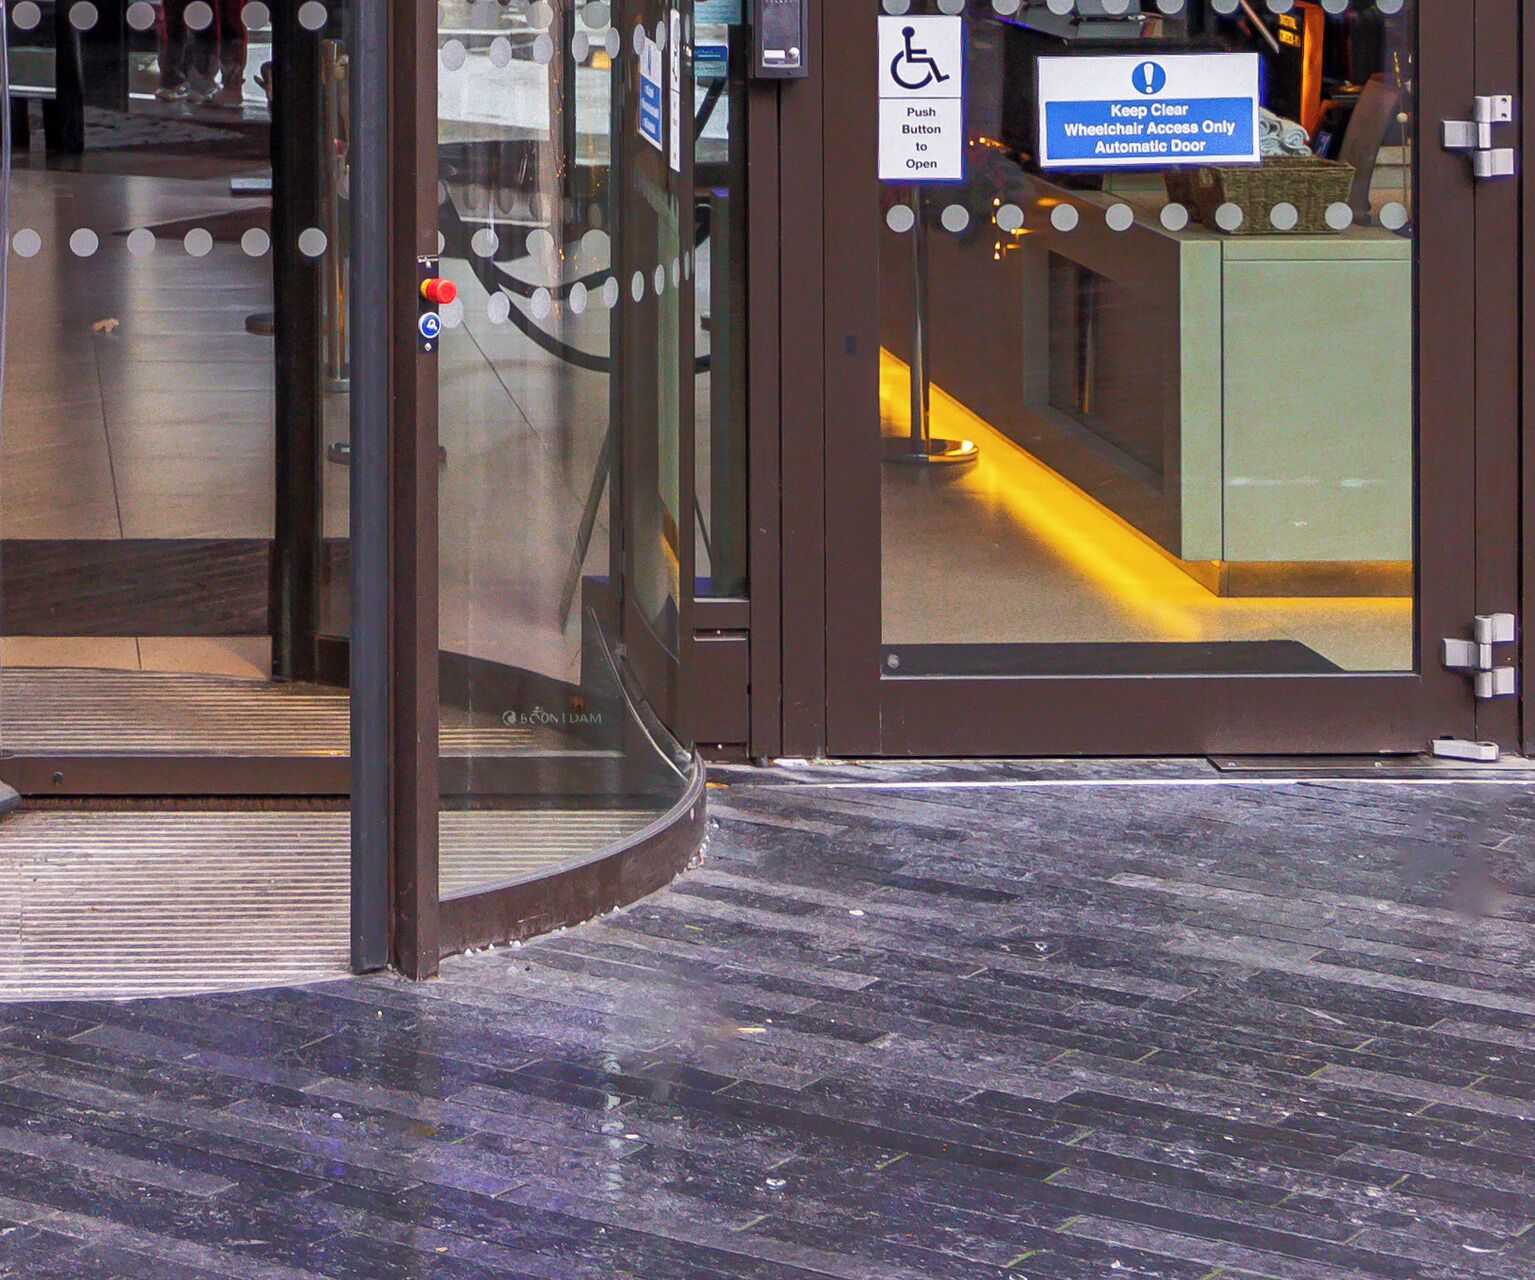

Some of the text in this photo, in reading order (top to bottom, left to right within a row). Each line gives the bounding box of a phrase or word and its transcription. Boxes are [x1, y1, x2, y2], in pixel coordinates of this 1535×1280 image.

[907, 107, 936, 117] Push
[1111, 103, 1188, 119] Keep Clear
[902, 124, 941, 134] Button
[1064, 120, 1235, 136] Wheelchair Access Only
[915, 142, 928, 152] to
[1095, 139, 1206, 154] Automatic Door
[906, 159, 937, 170] Open
